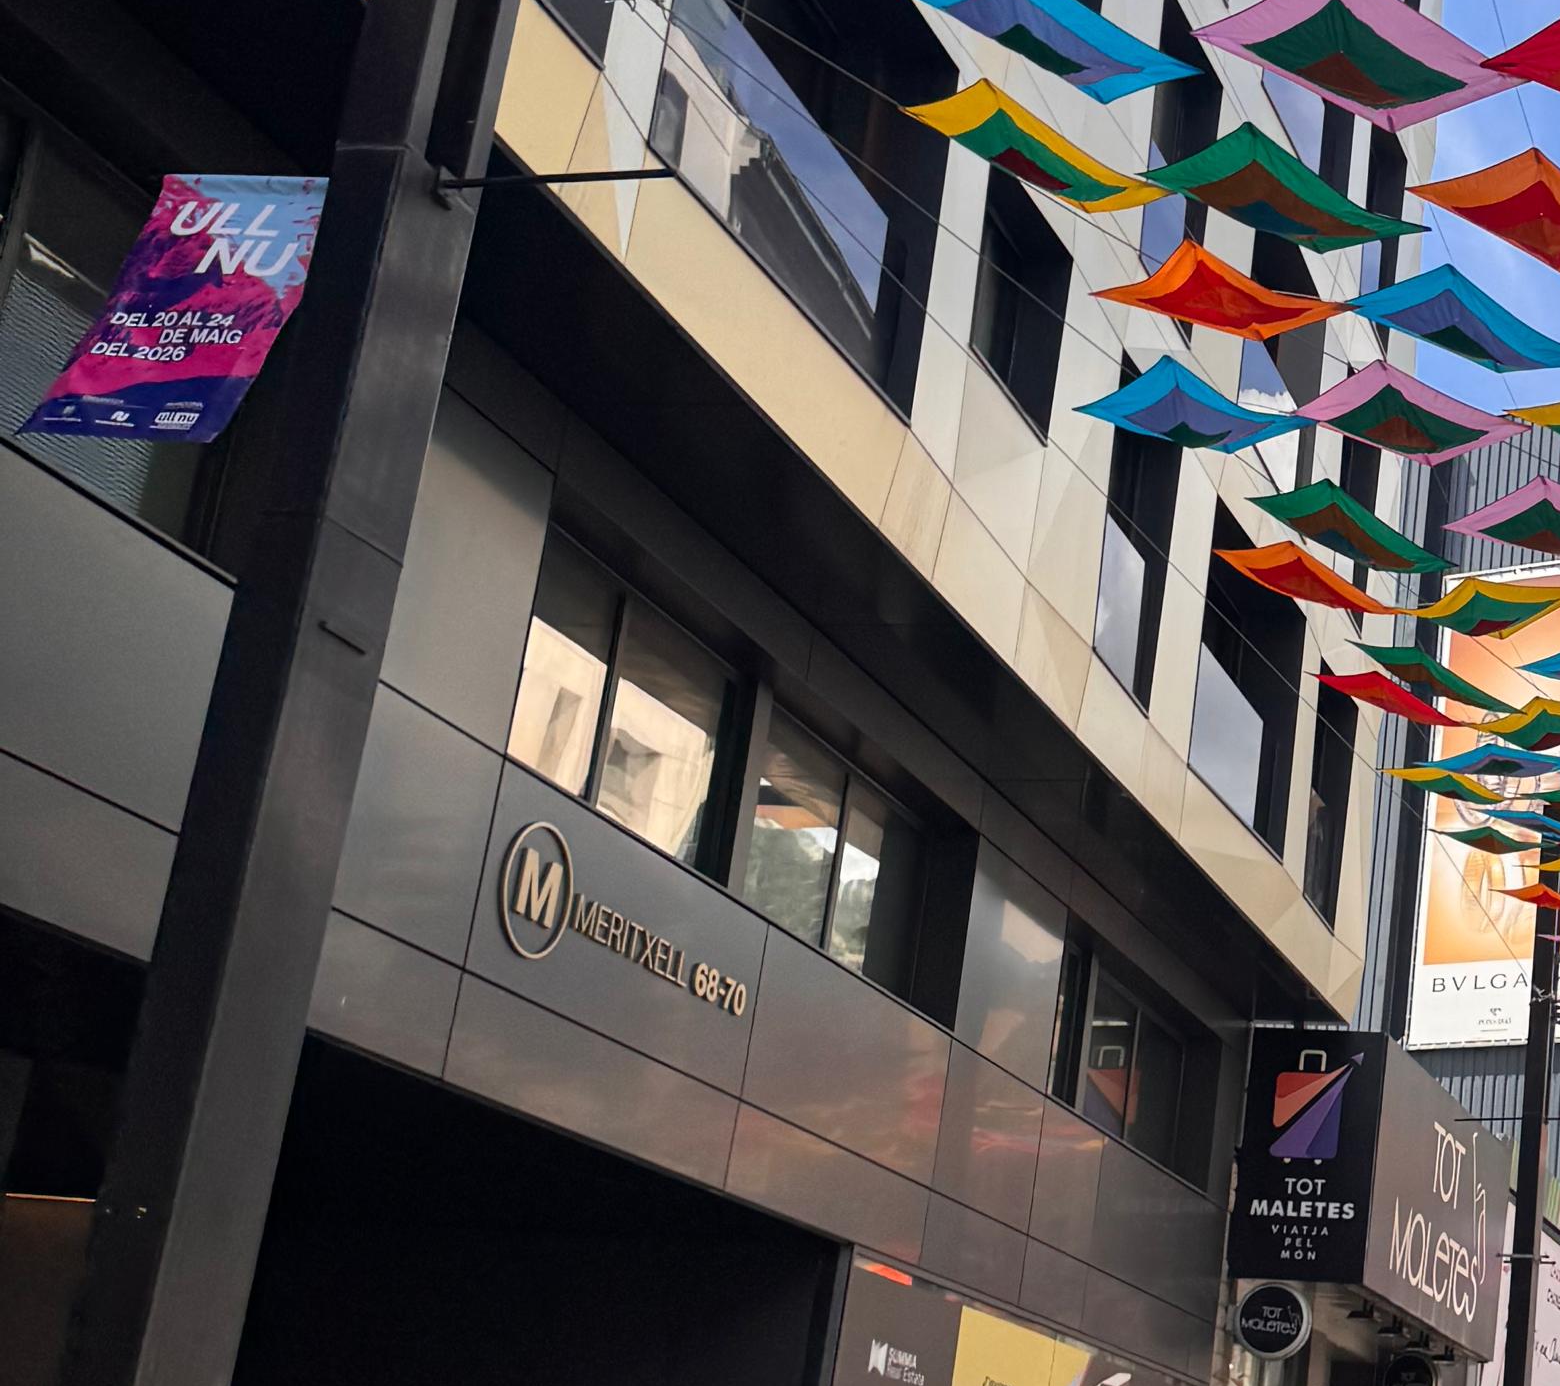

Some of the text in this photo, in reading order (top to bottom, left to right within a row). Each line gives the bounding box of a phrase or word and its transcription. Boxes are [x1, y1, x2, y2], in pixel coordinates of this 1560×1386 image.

[170, 201, 279, 237] ULL
[194, 239, 298, 277] NU
[110, 311, 235, 327] DEL 20 AL 24
[158, 328, 243, 344] DE MAIG
[91, 341, 187, 362] DEL 2026
[573, 893, 687, 988] MERITXELL
[693, 962, 747, 1017] 68-70
[1432, 972, 1529, 993] BVLGA
[1432, 1120, 1467, 1210] TOT
[1284, 1177, 1327, 1196] TOT
[1249, 1199, 1356, 1220] MALETES
[1271, 1224, 1329, 1236] VIATJA
[1284, 1237, 1313, 1248] PEL
